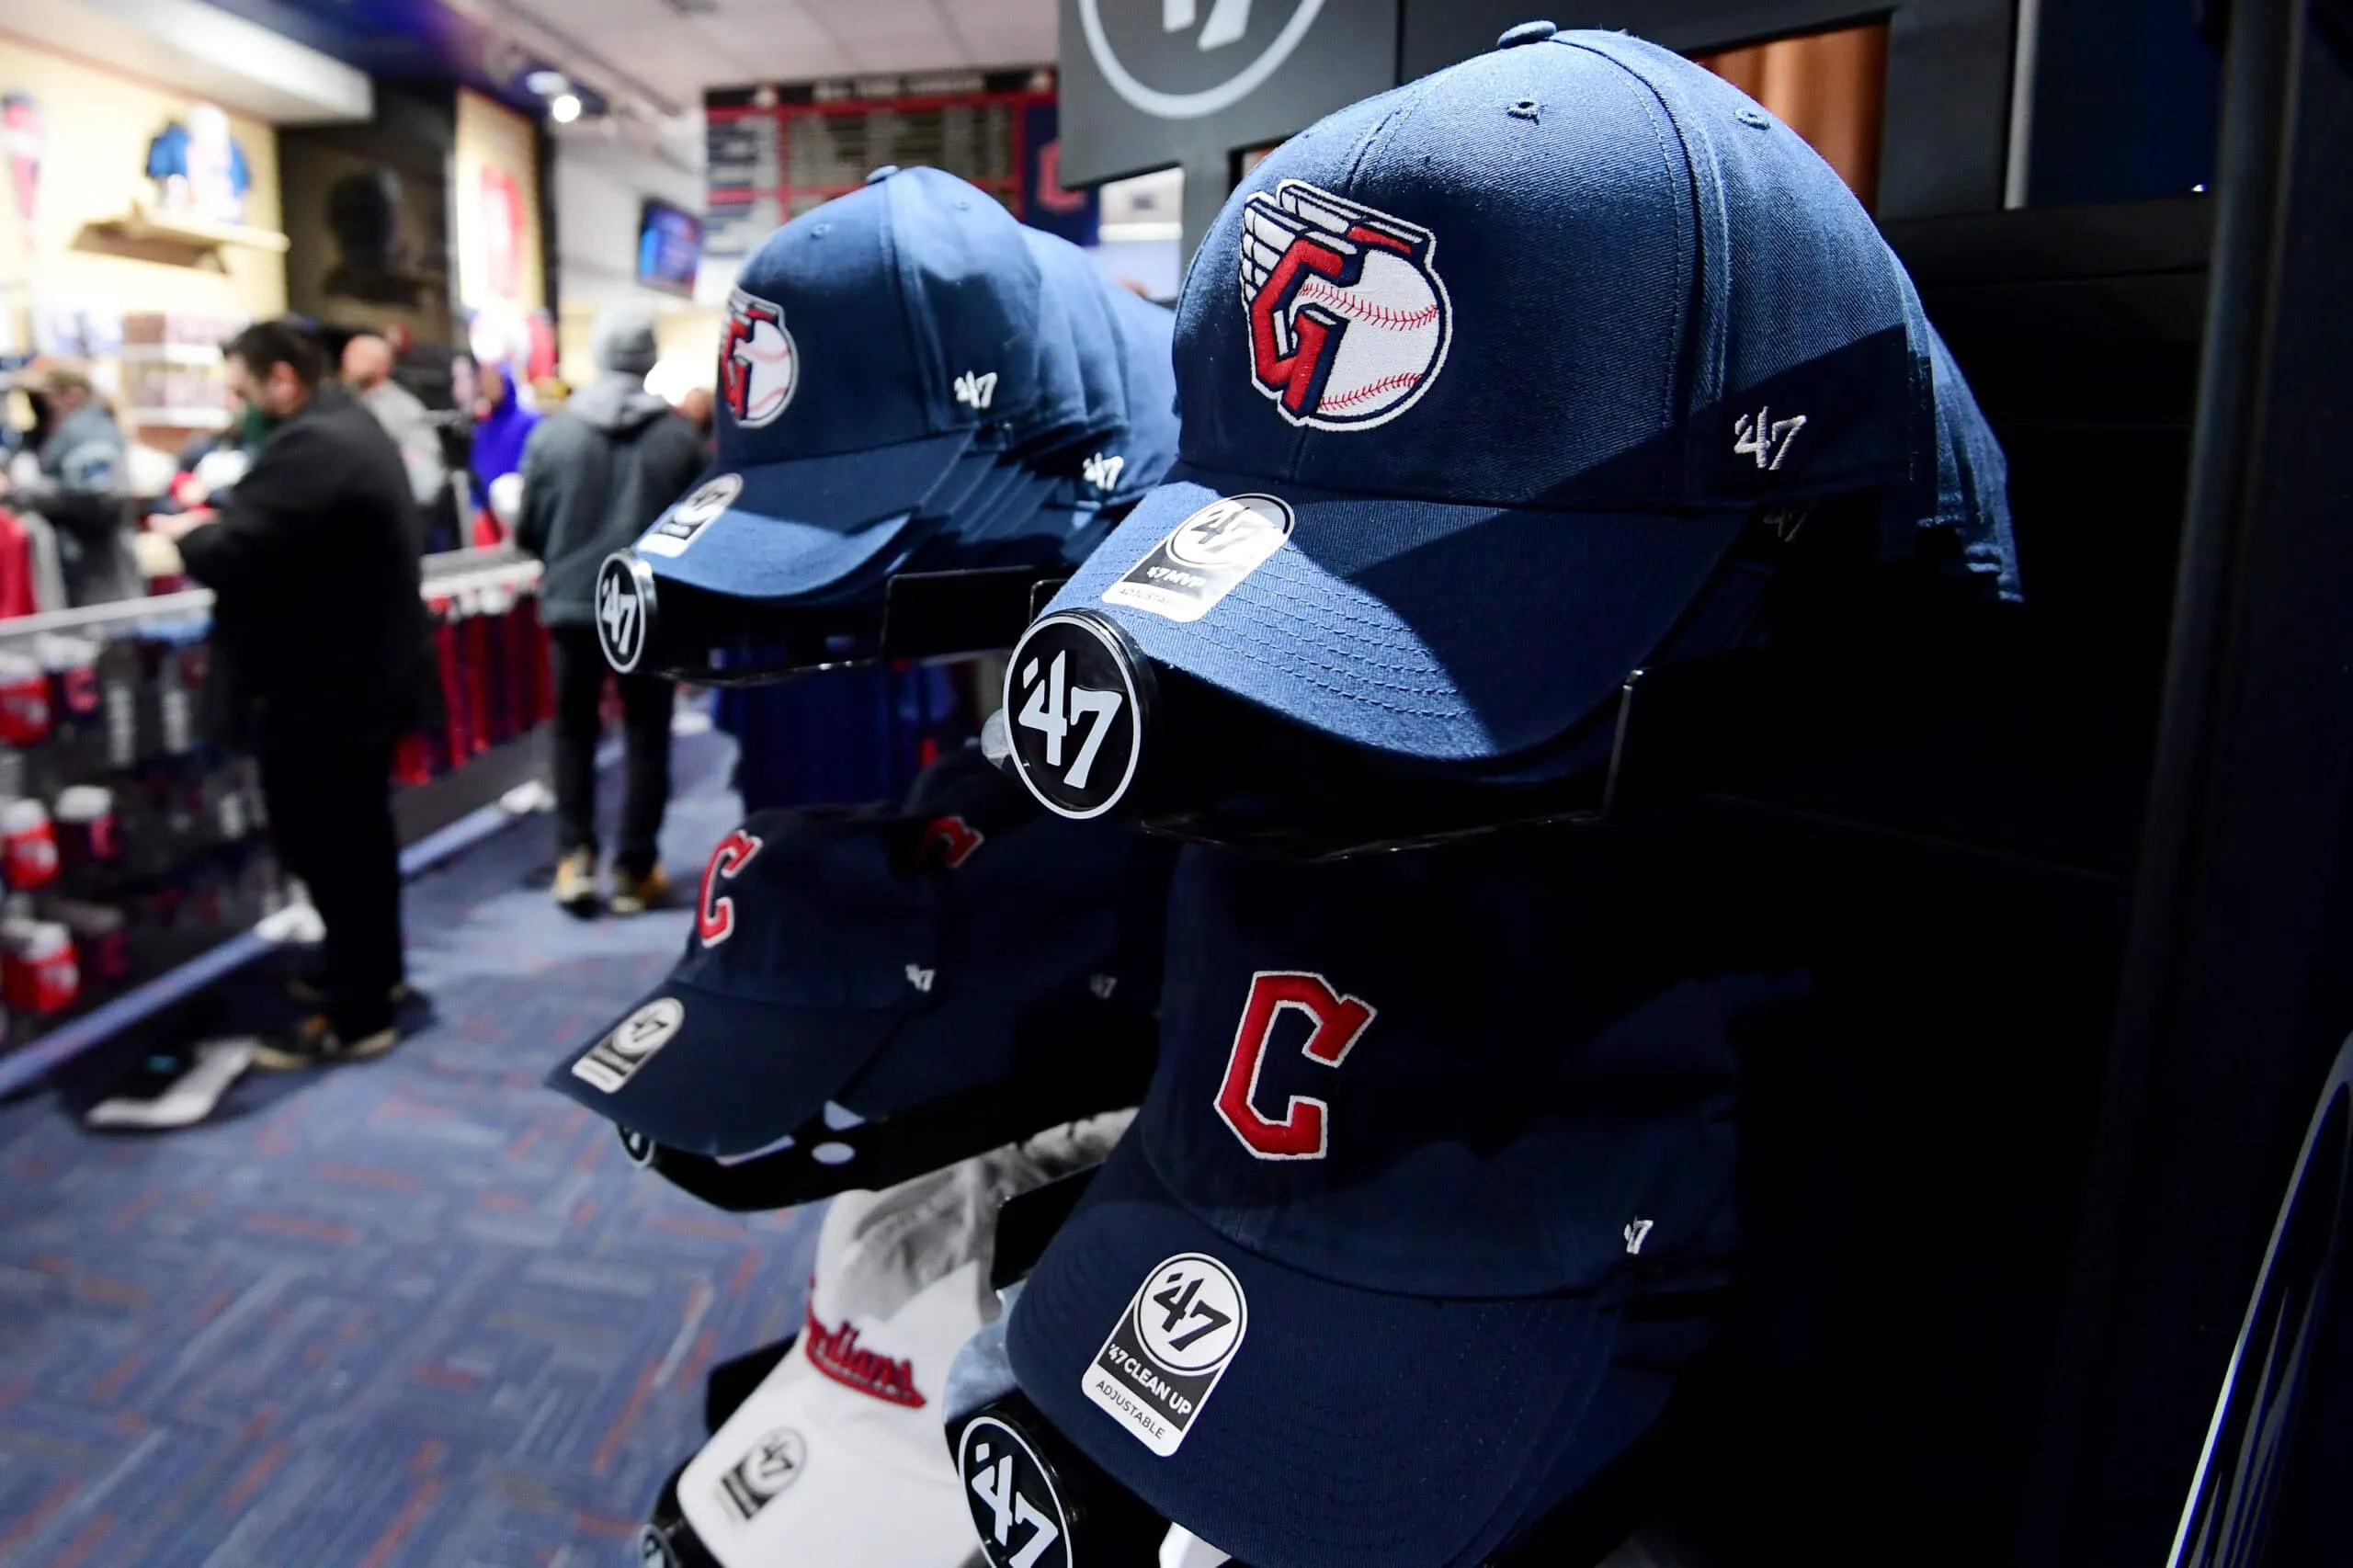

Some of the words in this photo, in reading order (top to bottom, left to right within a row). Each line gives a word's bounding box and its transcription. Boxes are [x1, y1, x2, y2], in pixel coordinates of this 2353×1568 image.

[697, 829, 764, 948] C
[1213, 971, 1378, 1161] C
[1095, 1381, 1166, 1440] ADJUSTABLE
[1124, 1356, 1172, 1402] CLEAN
[1168, 1390, 1193, 1416] UP
